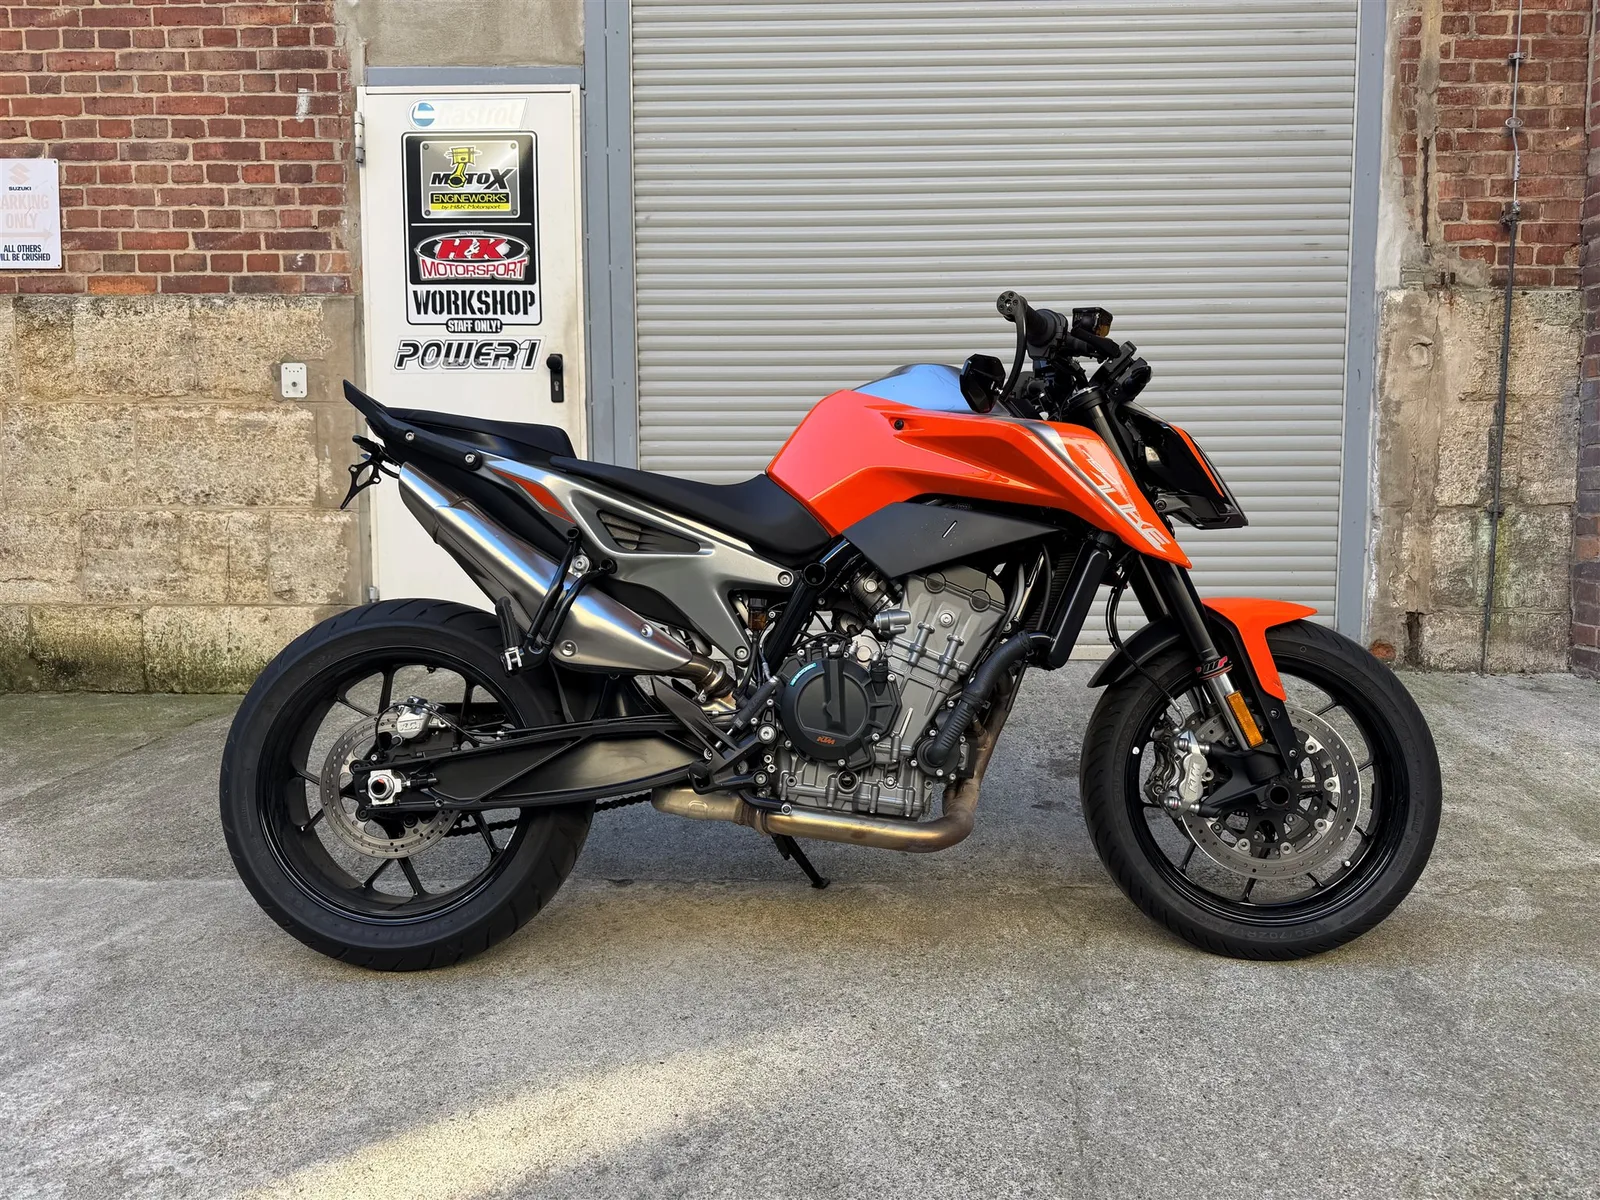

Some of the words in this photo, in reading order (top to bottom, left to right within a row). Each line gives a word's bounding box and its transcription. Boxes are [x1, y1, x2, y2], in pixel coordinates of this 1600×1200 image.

[0, 194, 49, 210] ARKING
[433, 194, 507, 203] ENGINEWORKS
[6, 213, 38, 229] ONLY
[3, 244, 16, 253] ALL
[17, 244, 42, 253] OTHERS
[12, 252, 20, 261] BE
[22, 252, 51, 261] CRUSHED
[436, 238, 508, 260] H&K
[421, 258, 527, 277] MOTORSPORT
[412, 290, 536, 316] WORKSHOP
[448, 320, 473, 333] STAFF
[474, 319, 501, 332] ONLY!
[394, 338, 542, 371] POWER1
[816, 735, 836, 745] KTM
